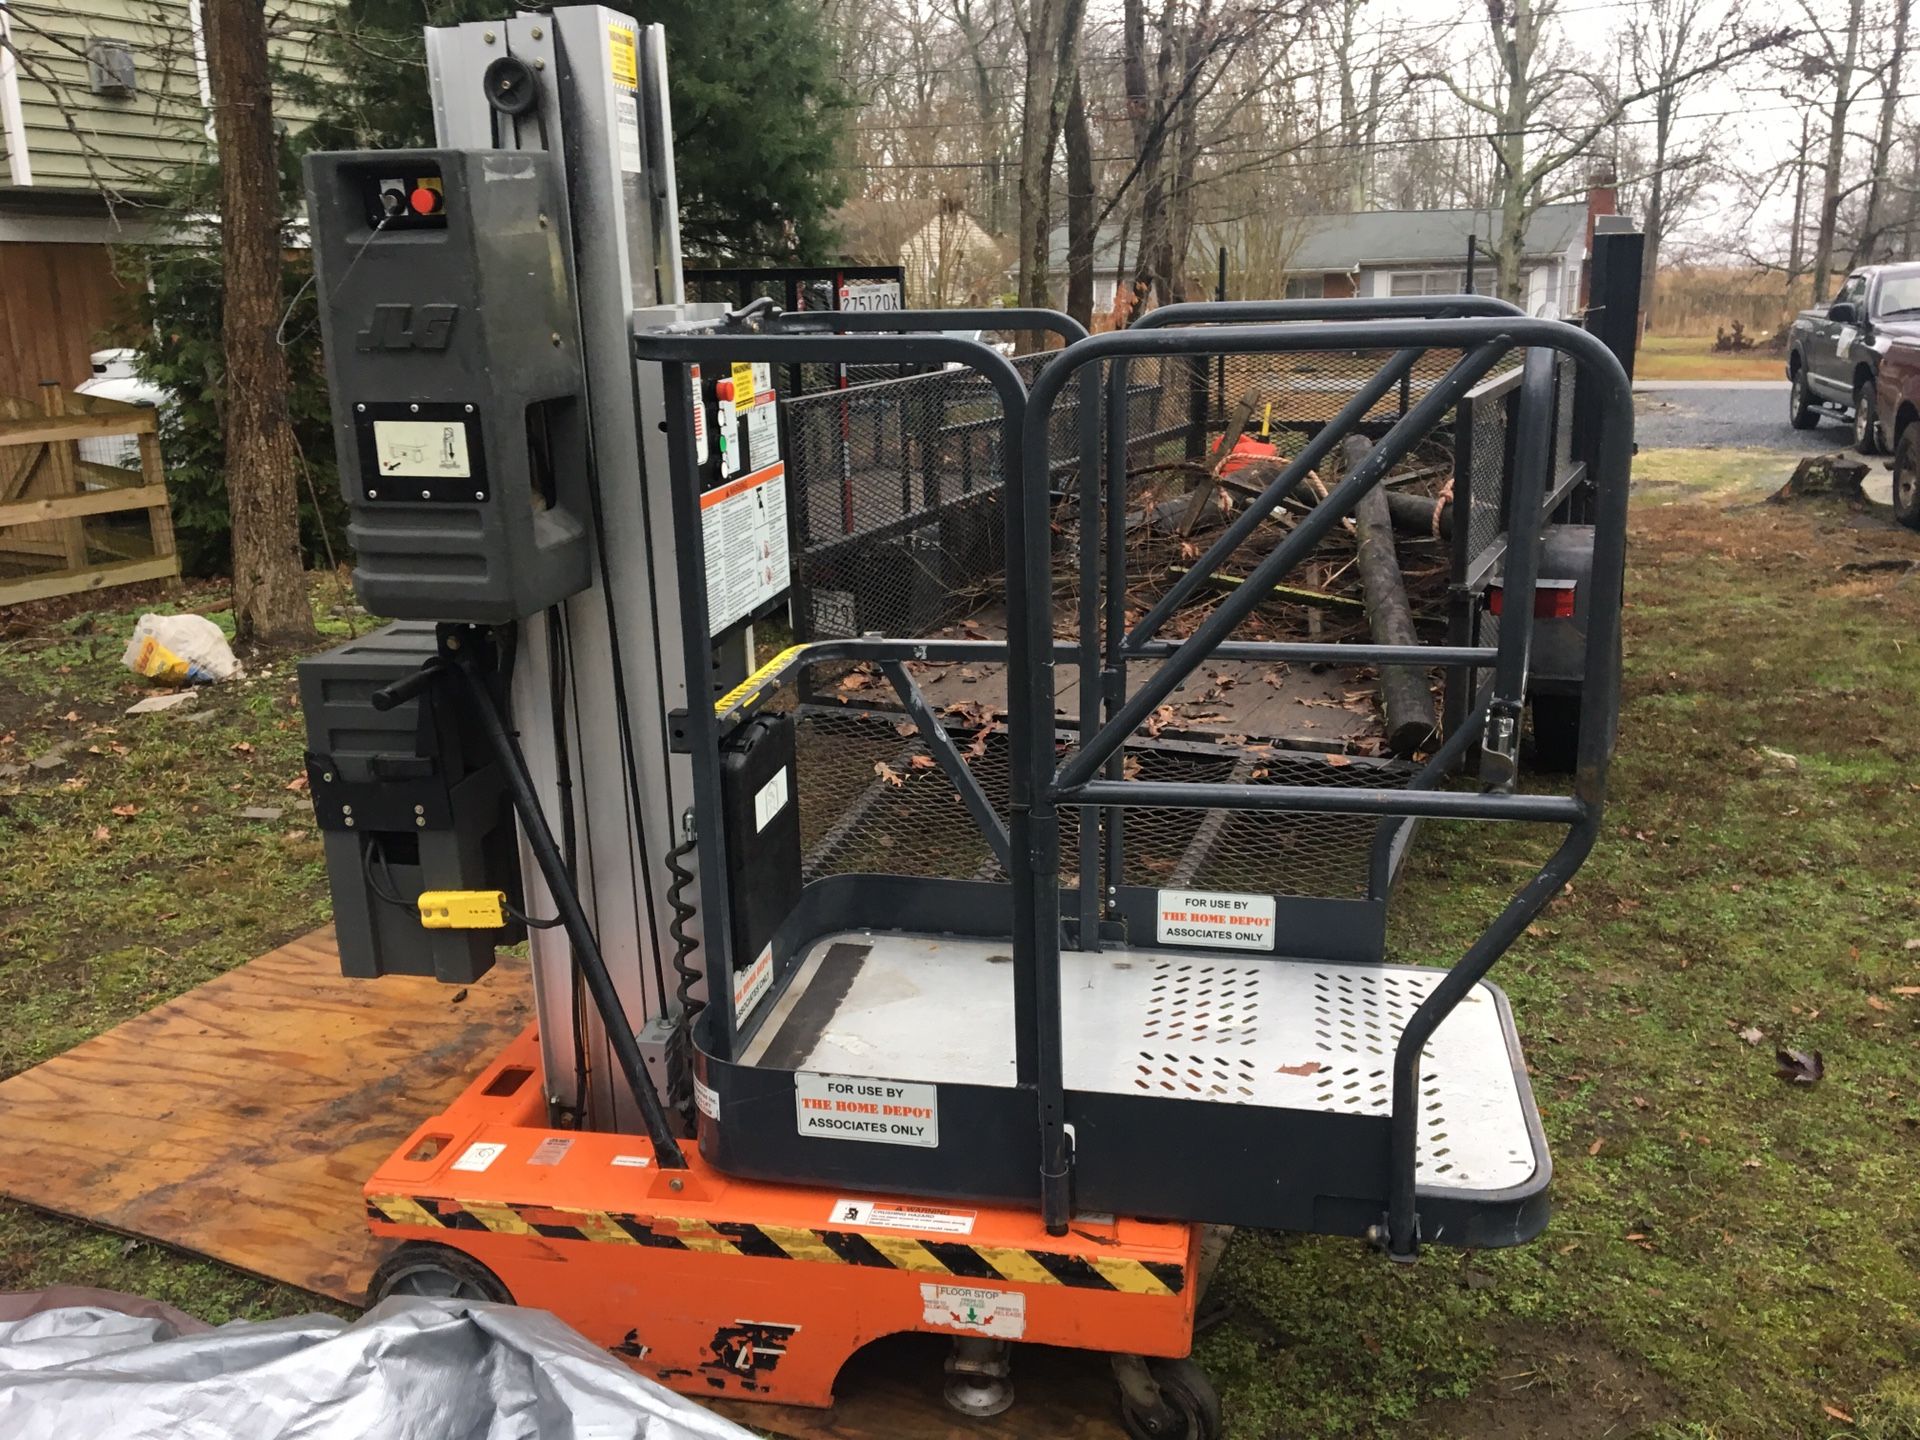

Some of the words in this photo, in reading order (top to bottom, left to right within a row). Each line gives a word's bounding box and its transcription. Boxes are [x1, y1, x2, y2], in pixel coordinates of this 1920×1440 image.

[356, 303, 459, 352] JLG
[1185, 898, 1207, 908] FOR
[1210, 900, 1231, 909] USE
[1234, 901, 1249, 910] BY
[1162, 911, 1187, 922] THE
[1190, 913, 1226, 924] HOME
[1229, 915, 1271, 927] DEPOT
[1166, 928, 1233, 940] ASSOCIATES
[1235, 932, 1264, 942] ONLY
[828, 1083, 855, 1095] FOR
[858, 1085, 883, 1096] USE
[886, 1088, 904, 1098] BY
[801, 1098, 832, 1110] THE
[836, 1101, 879, 1115] HOME
[883, 1104, 933, 1119] DEPOT
[808, 1117, 887, 1133] ASSOCIATES
[891, 1124, 924, 1137] ONLY
[907, 1206, 950, 1216] WARNING
[940, 1286, 972, 1297] FLOOR
[974, 1290, 999, 1300] STOP
[993, 1310, 1022, 1318] RELEASE
